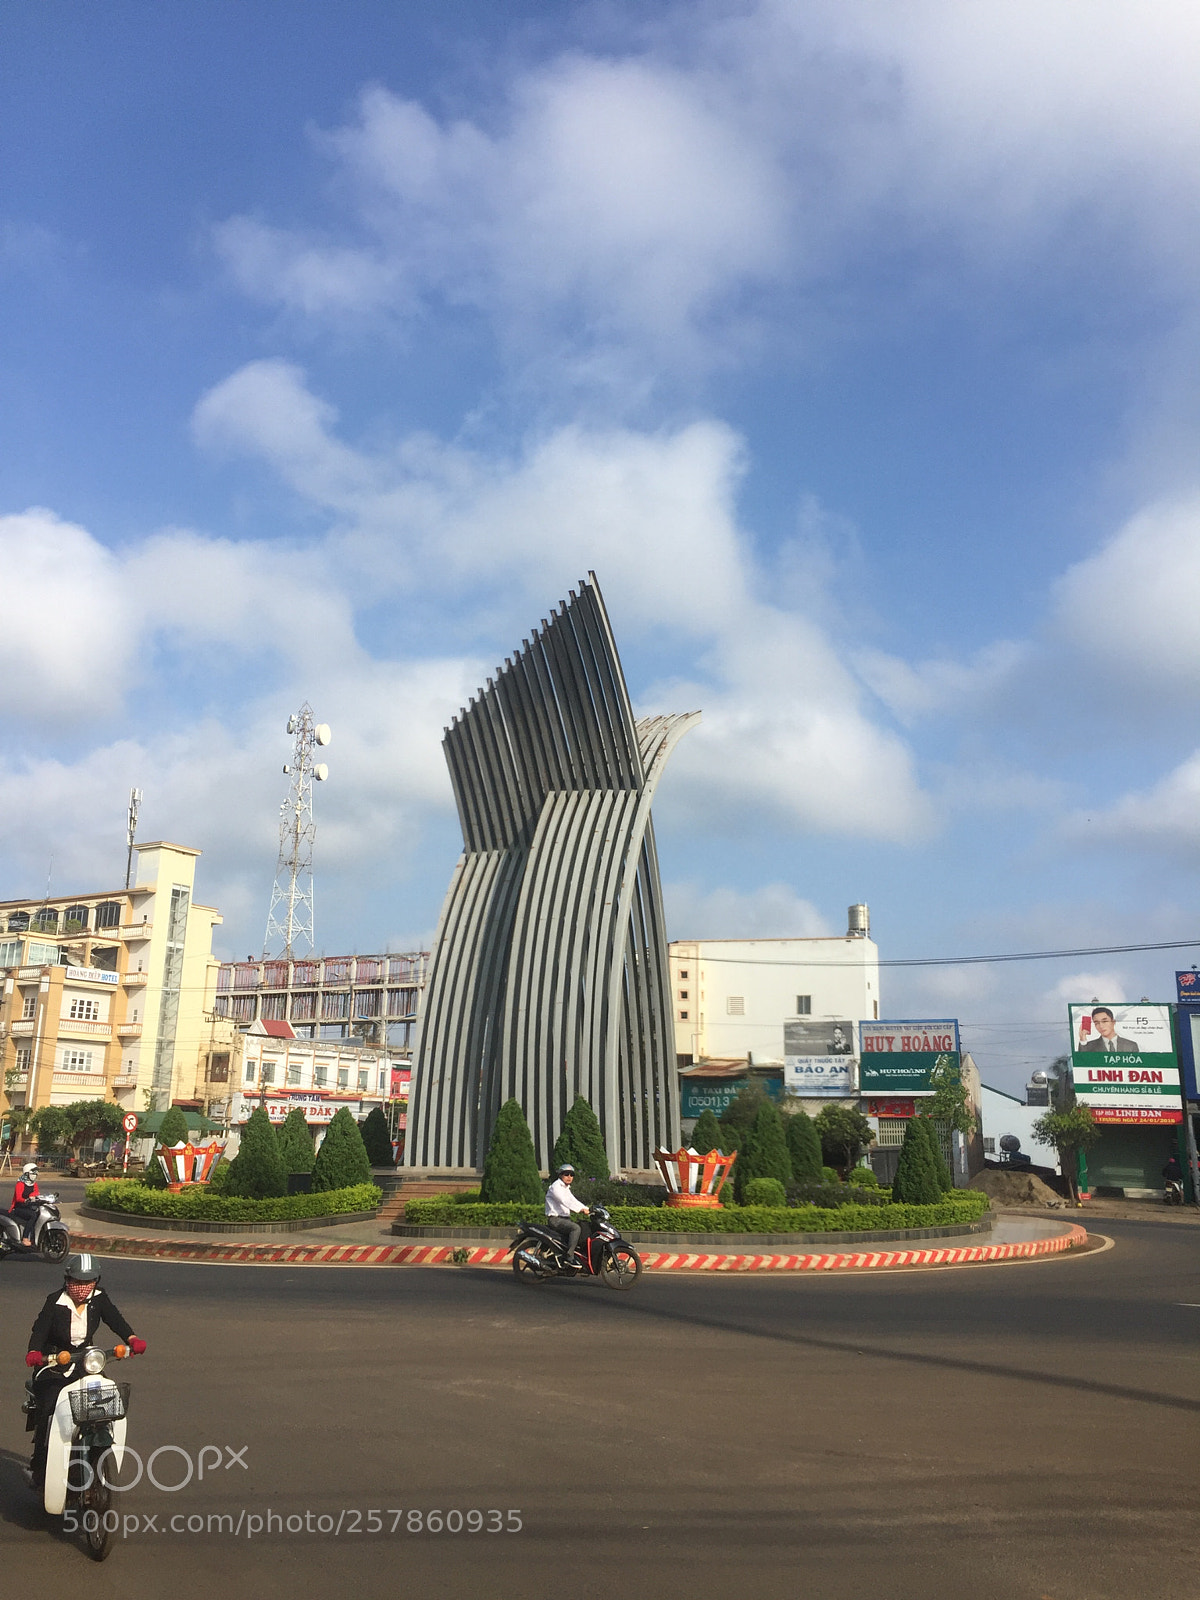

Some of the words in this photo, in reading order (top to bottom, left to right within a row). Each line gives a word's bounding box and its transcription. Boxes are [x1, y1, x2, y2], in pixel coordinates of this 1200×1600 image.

[101, 973, 118, 982] HOTEL
[1136, 1017, 1149, 1025] F5
[864, 1036, 896, 1052] HUY
[901, 1030, 953, 1052] HOÀNG
[1104, 1055, 1121, 1065] TẠP
[1088, 1070, 1123, 1082] LINH
[1128, 1070, 1163, 1083] ĐAN
[1120, 1086, 1140, 1094] HÀNG
[1115, 1109, 1139, 1117] LINH
